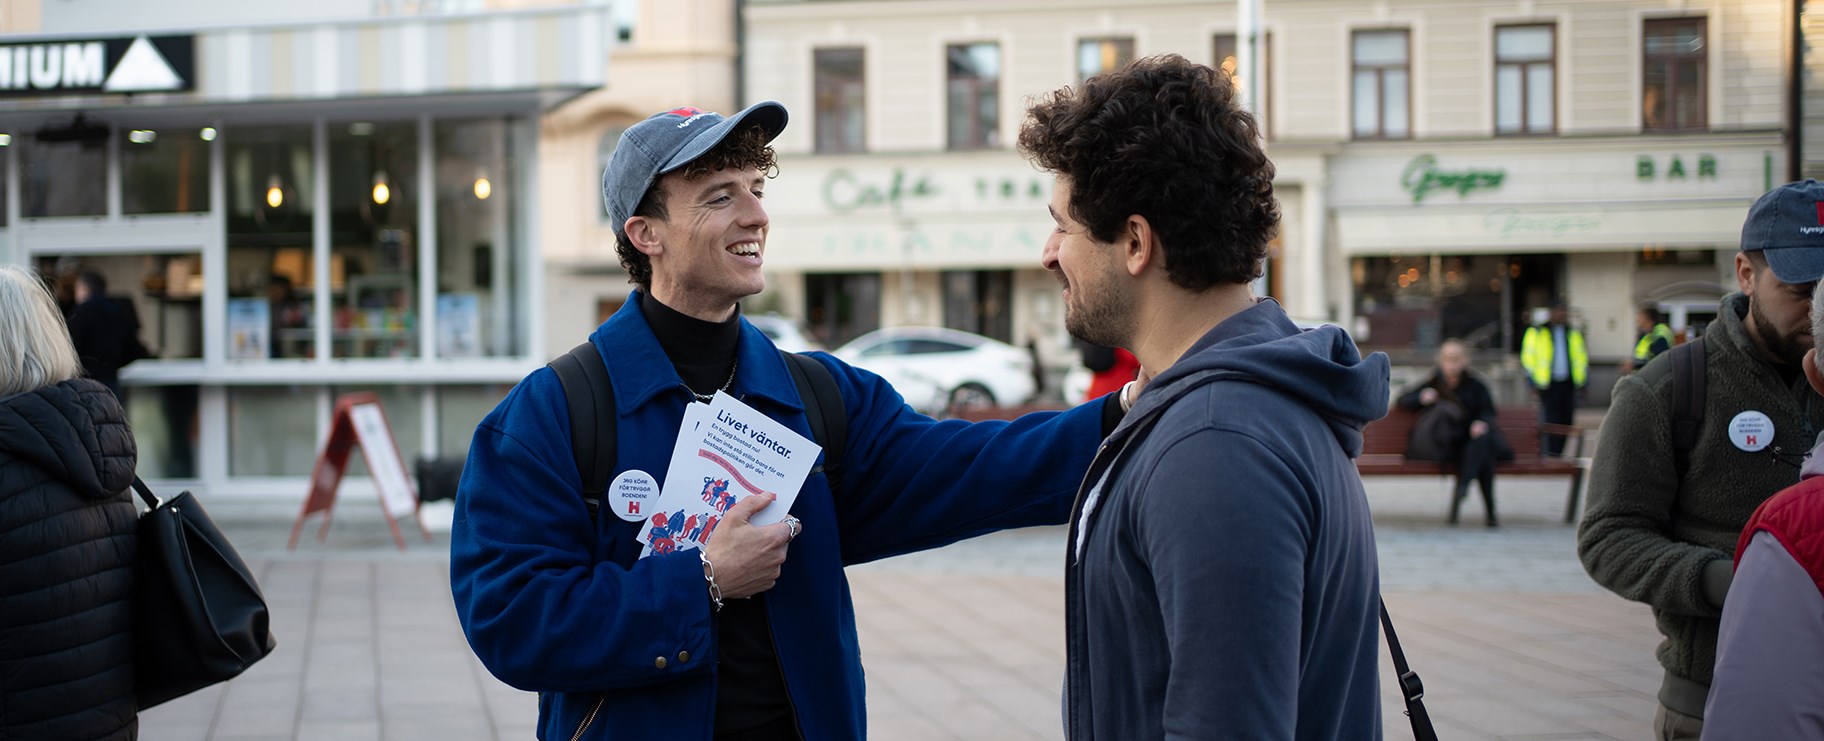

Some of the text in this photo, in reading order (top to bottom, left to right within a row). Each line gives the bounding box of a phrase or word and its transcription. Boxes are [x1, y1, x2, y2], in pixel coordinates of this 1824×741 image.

[0, 42, 104, 90] IUM
[1637, 155, 1717, 181] BAR
[975, 177, 1051, 198] TRA
[717, 409, 792, 459] Livet väntar.
[719, 426, 733, 439] trygg
[733, 434, 752, 449] bostad
[1746, 435, 1757, 445] H
[703, 438, 746, 465] bostadspolitiken
[713, 434, 722, 444] kan
[723, 440, 733, 450] inte
[733, 446, 742, 455] stå
[755, 459, 768, 470] bara
[628, 501, 640, 514] H
